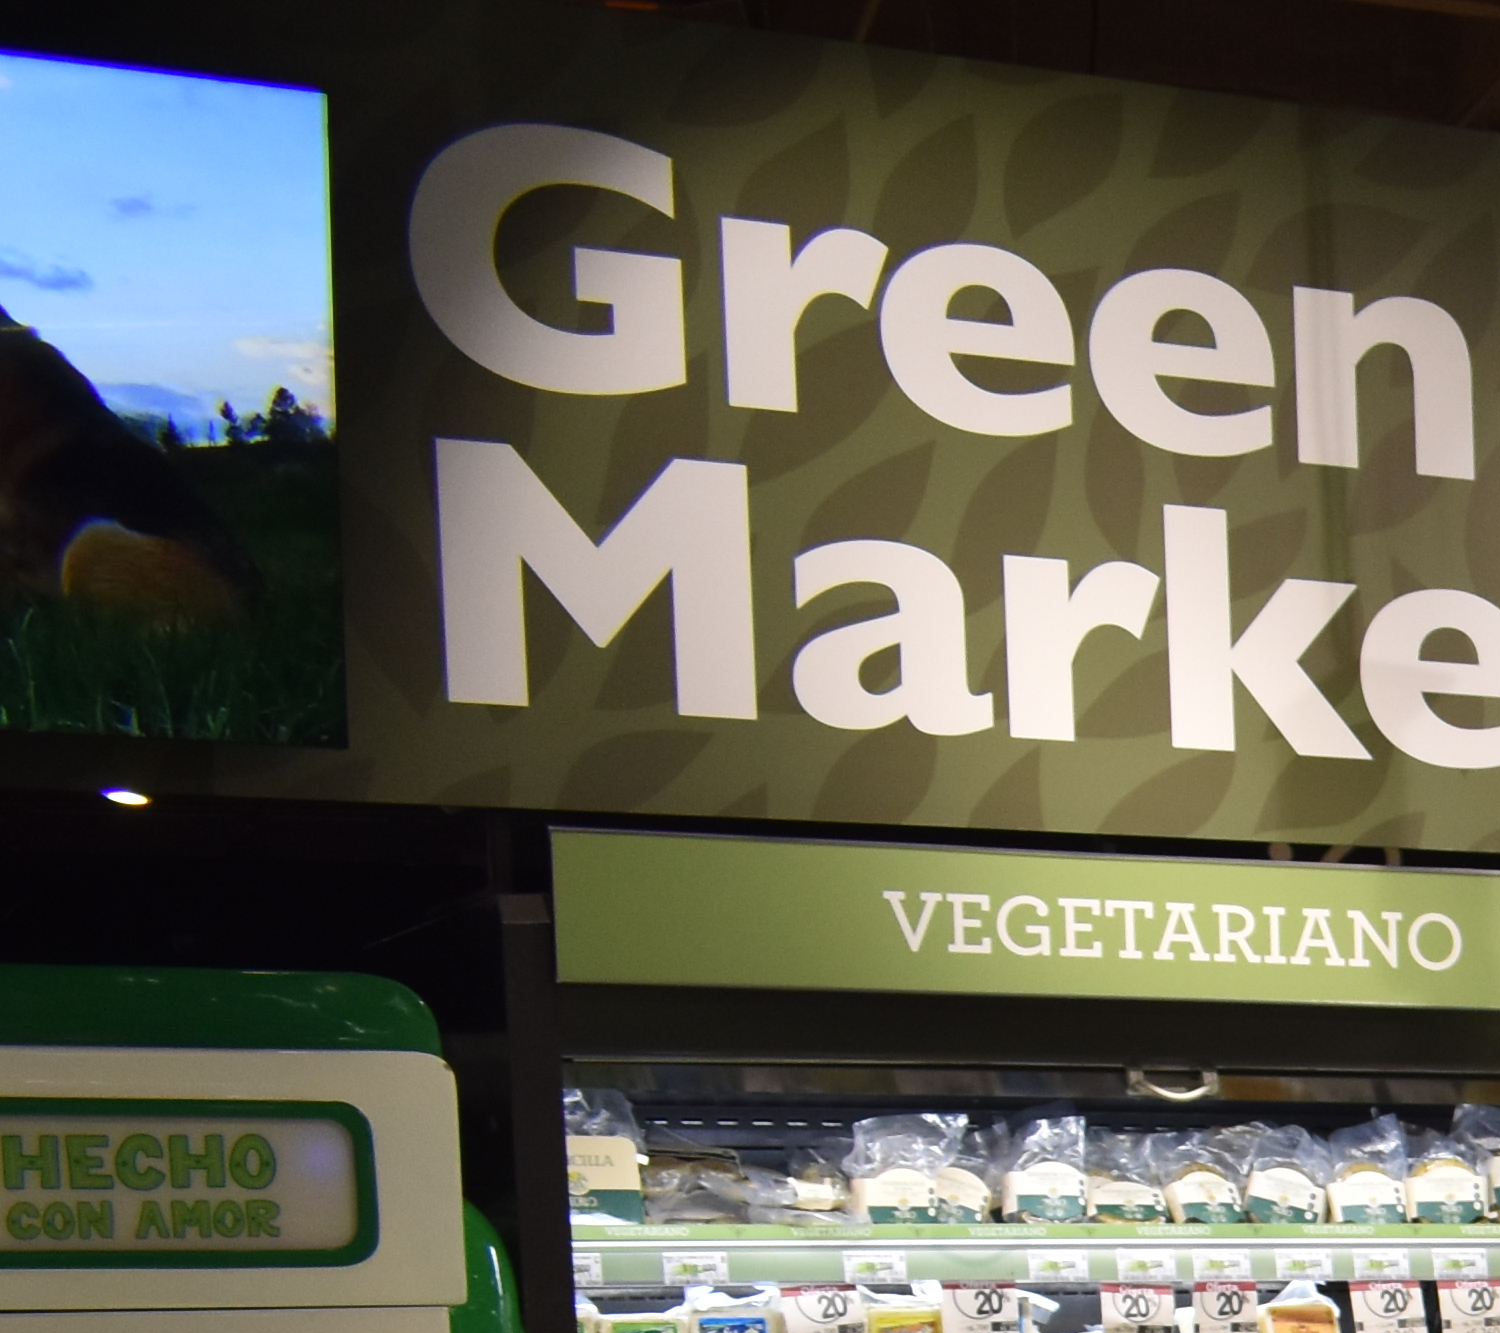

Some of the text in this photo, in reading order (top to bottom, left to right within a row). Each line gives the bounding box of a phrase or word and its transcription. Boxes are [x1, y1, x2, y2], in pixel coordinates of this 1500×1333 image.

[408, 122, 1476, 481] Green
[880, 885, 1467, 976] VEGETARIANO
[1, 1132, 277, 1191] HECHO
[6, 1198, 281, 1241] CON AMOR
